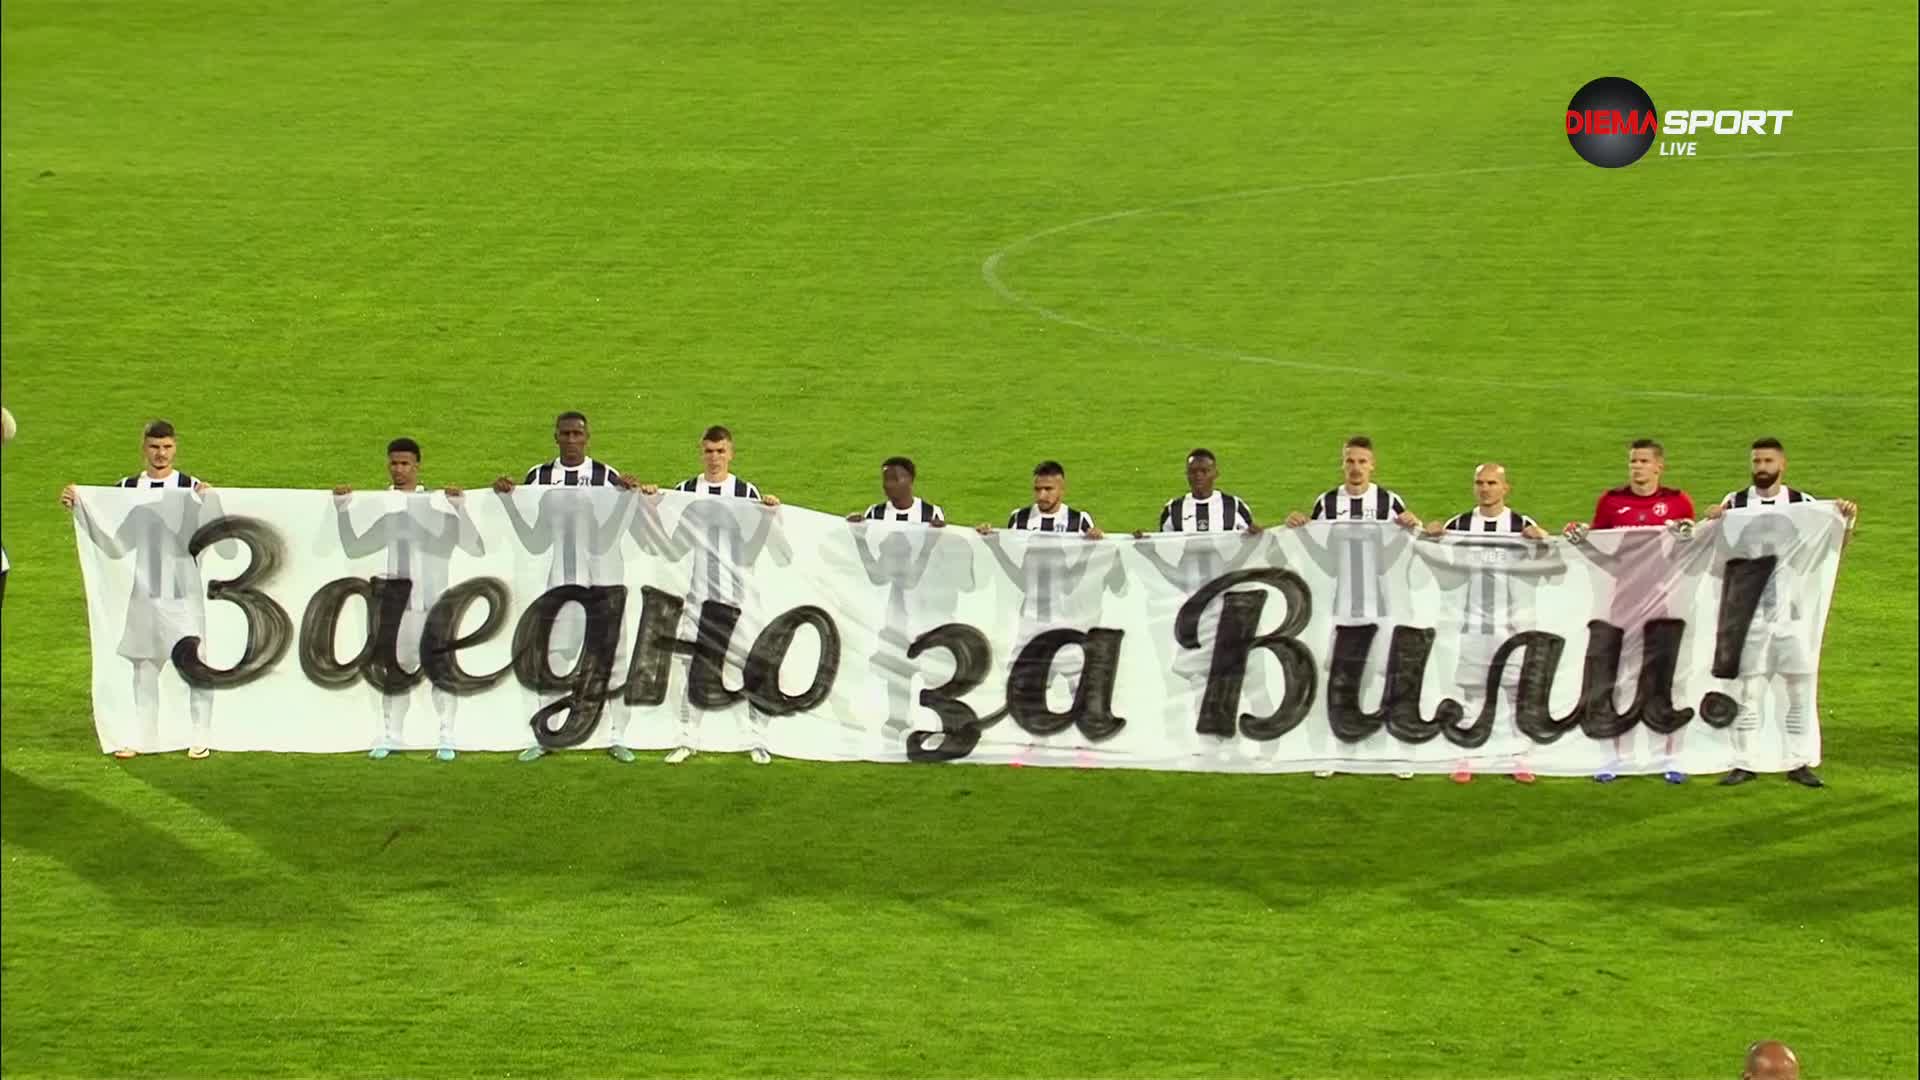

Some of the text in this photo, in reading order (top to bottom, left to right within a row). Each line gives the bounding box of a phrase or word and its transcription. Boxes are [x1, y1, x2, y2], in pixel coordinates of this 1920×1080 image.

[171, 515, 1778, 762] Заедно за Вили!
